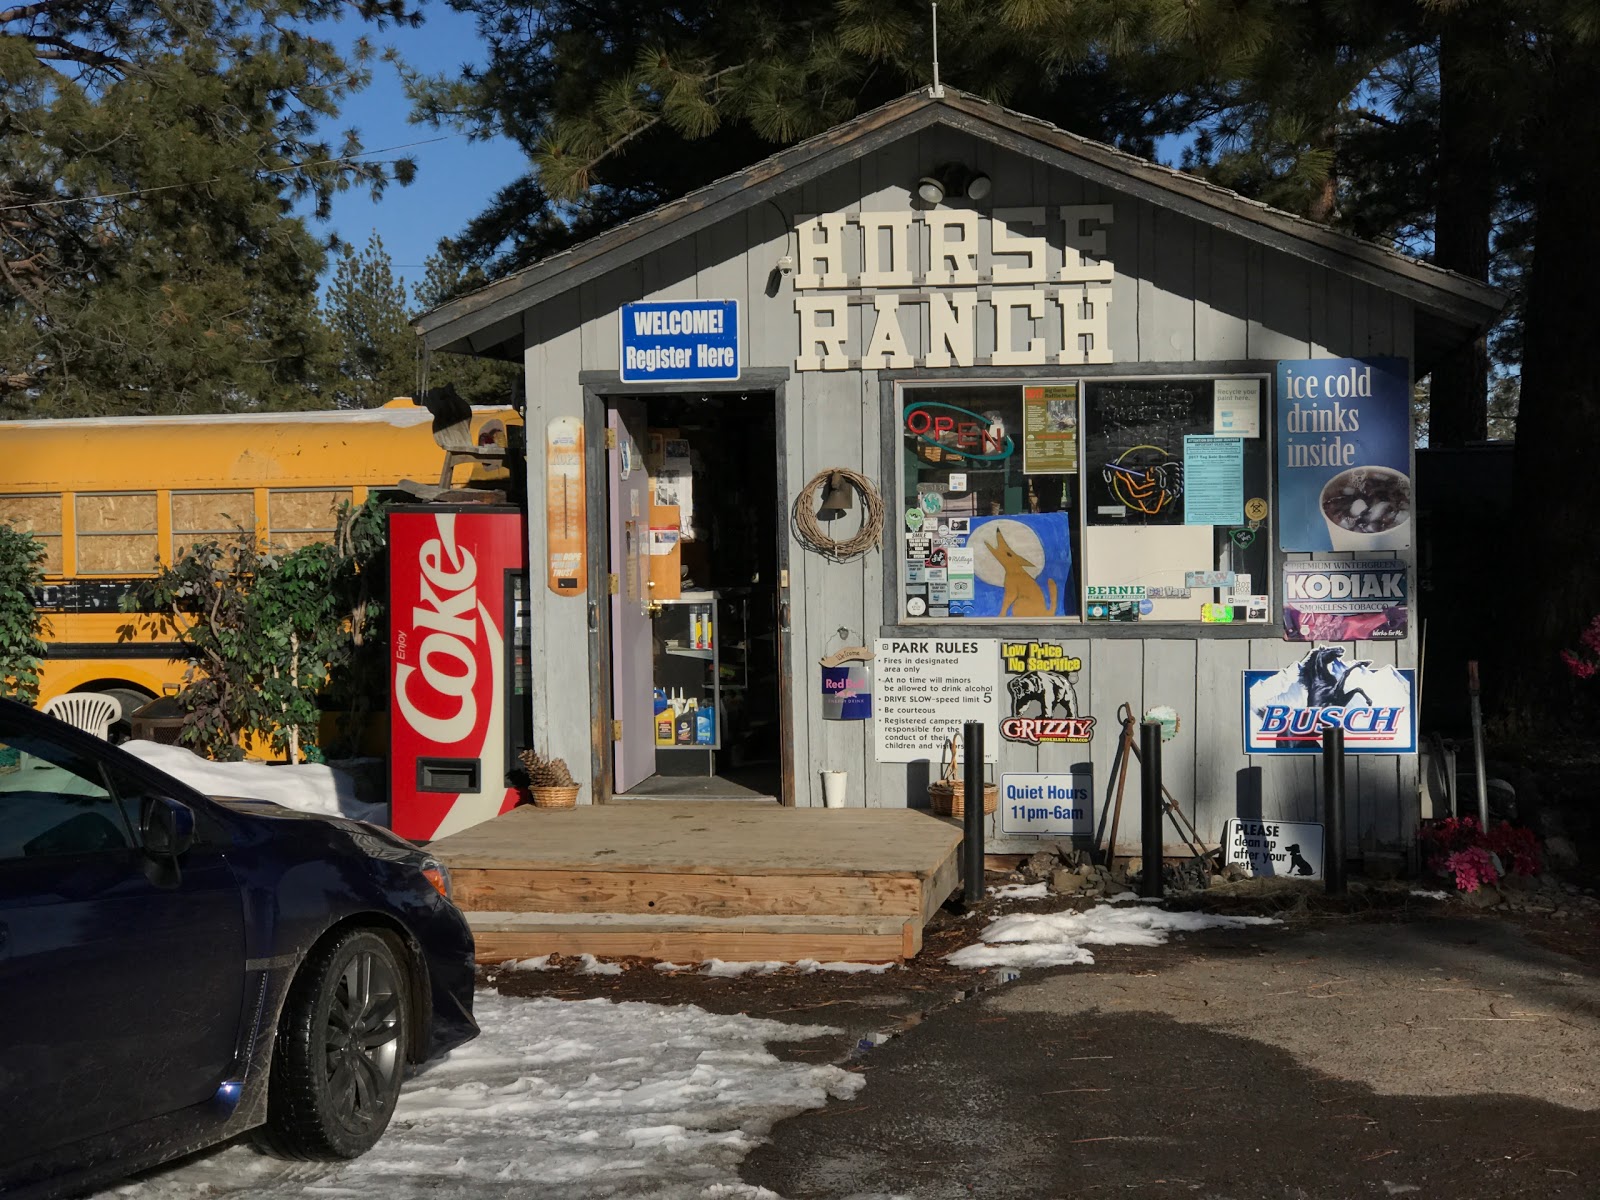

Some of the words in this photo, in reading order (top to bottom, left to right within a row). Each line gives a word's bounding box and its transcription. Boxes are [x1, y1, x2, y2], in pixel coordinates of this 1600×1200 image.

[794, 204, 1114, 289] HORSE
[633, 309, 724, 335] WELCOME!
[795, 287, 1113, 370] RANCH
[626, 345, 692, 372] Register
[697, 343, 734, 367] Here
[1286, 369, 1318, 399] ice
[1324, 366, 1372, 398] cold
[1217, 388, 1241, 396] Recycle
[1287, 401, 1360, 433] drinks
[907, 410, 1002, 453] OPEN
[1287, 436, 1355, 468] inside
[552, 568, 574, 577] TRUST
[1291, 562, 1331, 570] PREMIUM
[1333, 561, 1396, 569] WINTERGREEN
[1194, 572, 1228, 585] RAW
[1286, 572, 1405, 599] KODIAK
[1087, 585, 1146, 595] BERNIE
[1165, 586, 1191, 599] Vape
[1299, 603, 1347, 611] SMOKELESS
[1350, 602, 1389, 611] TOBACCO
[395, 513, 478, 743] Coke
[396, 629, 408, 660] Enjoy
[892, 642, 929, 653] PARK
[935, 642, 979, 653] RULES
[1002, 643, 1027, 657] Low
[1029, 643, 1062, 658] Price
[836, 651, 860, 660] Welcome
[915, 657, 959, 665] designated
[1008, 657, 1025, 672] No
[1028, 657, 1081, 671] Sacrifice
[825, 678, 844, 689] Red
[845, 678, 865, 689] Bull
[909, 695, 960, 704] SLOW-speed
[983, 692, 992, 703] 5
[884, 717, 927, 725] Registered
[1258, 704, 1404, 734] BUSCH
[884, 726, 929, 734] responsible
[1003, 719, 1092, 741] GRIZZLY
[1007, 784, 1044, 801] Quiet
[1047, 785, 1088, 800] Hours
[1011, 805, 1084, 823] 11pm-6am
[1235, 823, 1280, 837] PLEASE
[1234, 834, 1260, 848] clean
[1263, 840, 1276, 851] up
[1233, 847, 1260, 861] after
[1263, 851, 1287, 864] your
[1240, 861, 1259, 871] ets.
